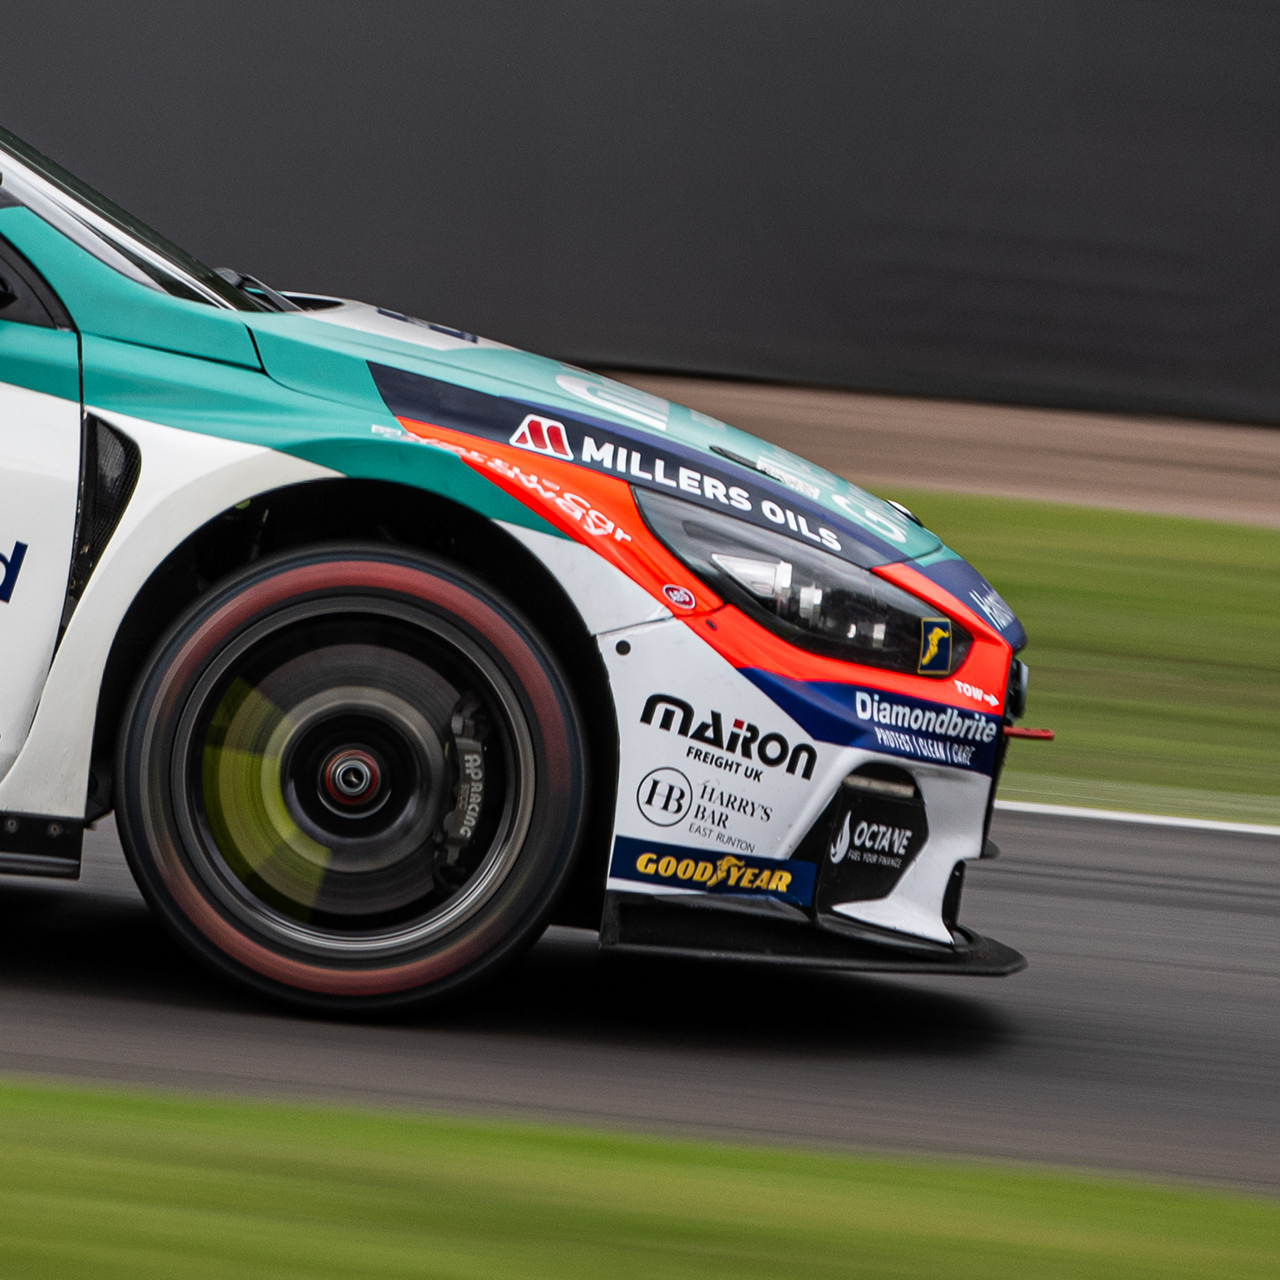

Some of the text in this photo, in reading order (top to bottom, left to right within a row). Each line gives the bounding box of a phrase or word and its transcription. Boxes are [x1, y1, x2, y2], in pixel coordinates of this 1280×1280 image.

[581, 435, 752, 512] MILLERS
[761, 499, 843, 551] OILS
[954, 680, 983, 702] TOW
[855, 691, 997, 744] Diamondbrite
[874, 726, 912, 753] PROTECT
[920, 738, 946, 762] CLEAN
[686, 746, 764, 783] FREIGHT UK
[694, 804, 730, 829] BAR
[700, 784, 773, 823] HARRY'S
[688, 822, 756, 854] EAST RUNTON
[853, 820, 913, 856] OCTANE
[636, 853, 792, 893] GOODYEAR
